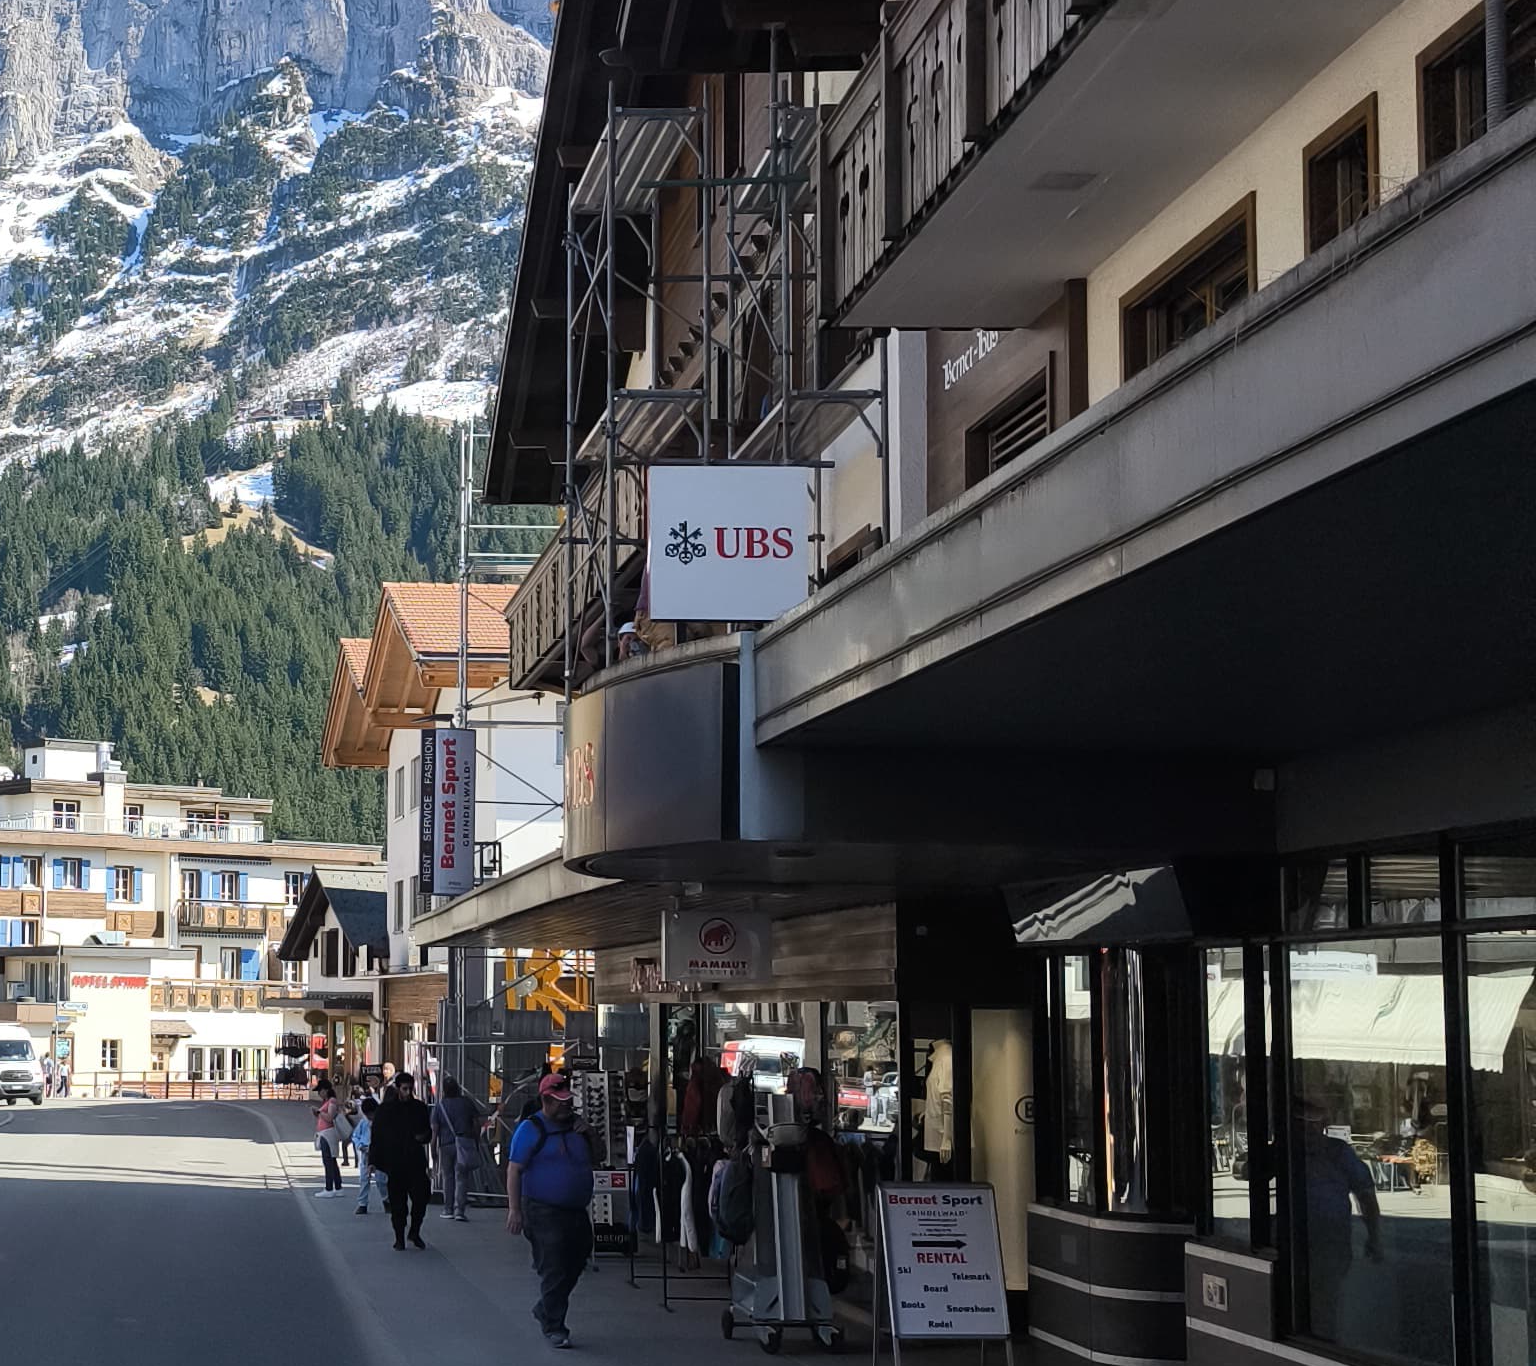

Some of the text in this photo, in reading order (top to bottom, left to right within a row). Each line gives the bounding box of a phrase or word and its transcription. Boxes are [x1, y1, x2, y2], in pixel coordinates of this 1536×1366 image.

[714, 527, 794, 559] UBS
[442, 738, 460, 795] Sport
[422, 737, 433, 882] RENT SERVICE FASHION
[441, 801, 456, 869] Bernet
[689, 960, 748, 969] MAMMUT
[888, 1194, 983, 1207] Bernet Sport
[917, 1252, 968, 1264] RENTAL
[897, 1266, 912, 1274] Ski
[952, 1272, 991, 1281] Telemark
[923, 1284, 949, 1293] Board
[901, 1301, 926, 1309] Boots
[946, 1305, 996, 1313] Snowshoes
[928, 1320, 953, 1329] Rodel
